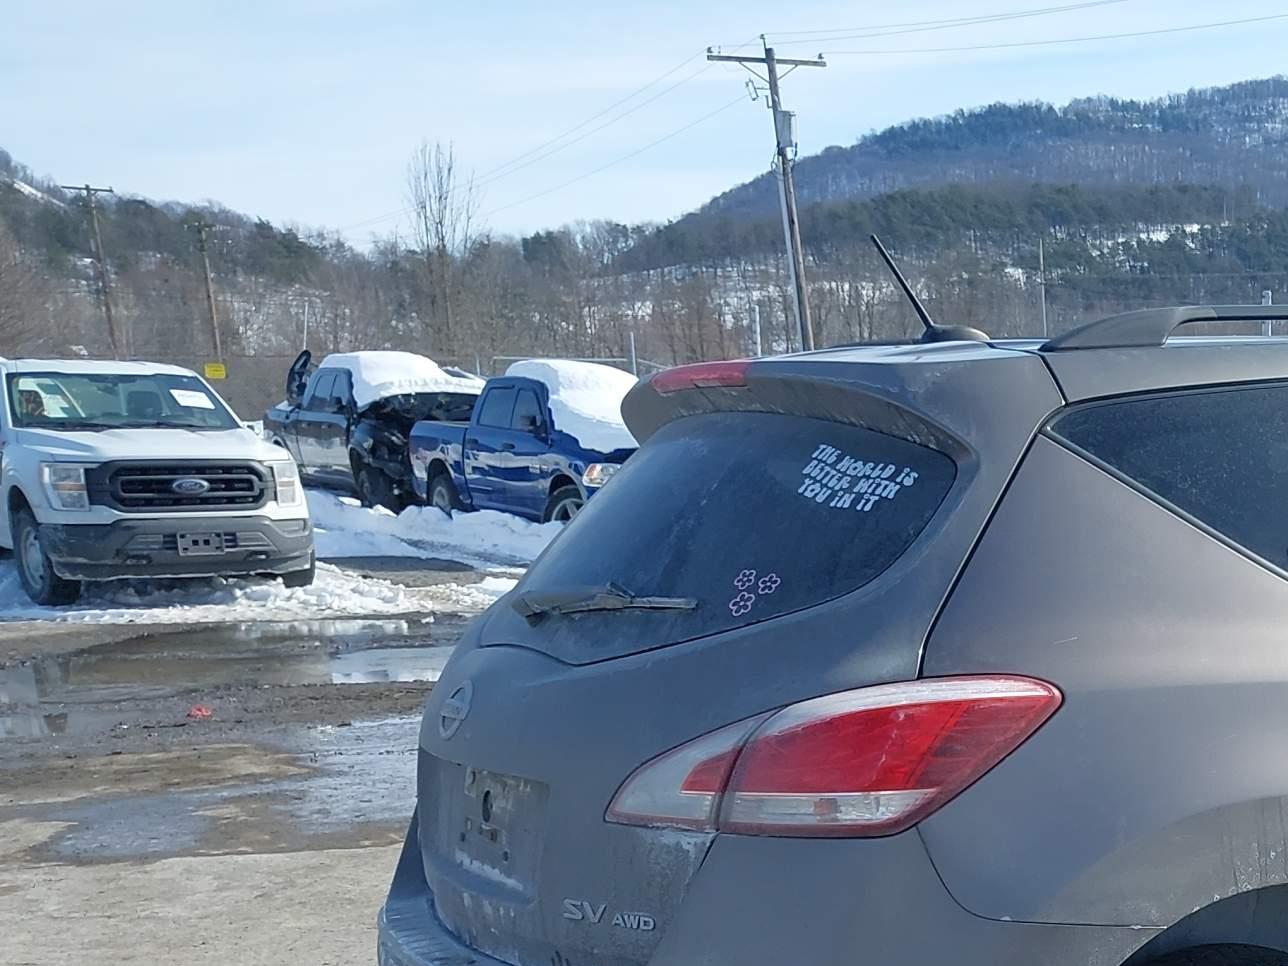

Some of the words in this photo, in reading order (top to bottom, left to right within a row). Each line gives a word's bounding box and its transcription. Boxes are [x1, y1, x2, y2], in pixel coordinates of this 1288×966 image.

[802, 460, 851, 490] BETTER
[811, 444, 841, 464] THE
[836, 455, 896, 478] WORLD
[797, 478, 832, 503] YOU
[563, 899, 608, 924] SV
[612, 912, 657, 931] AWD
